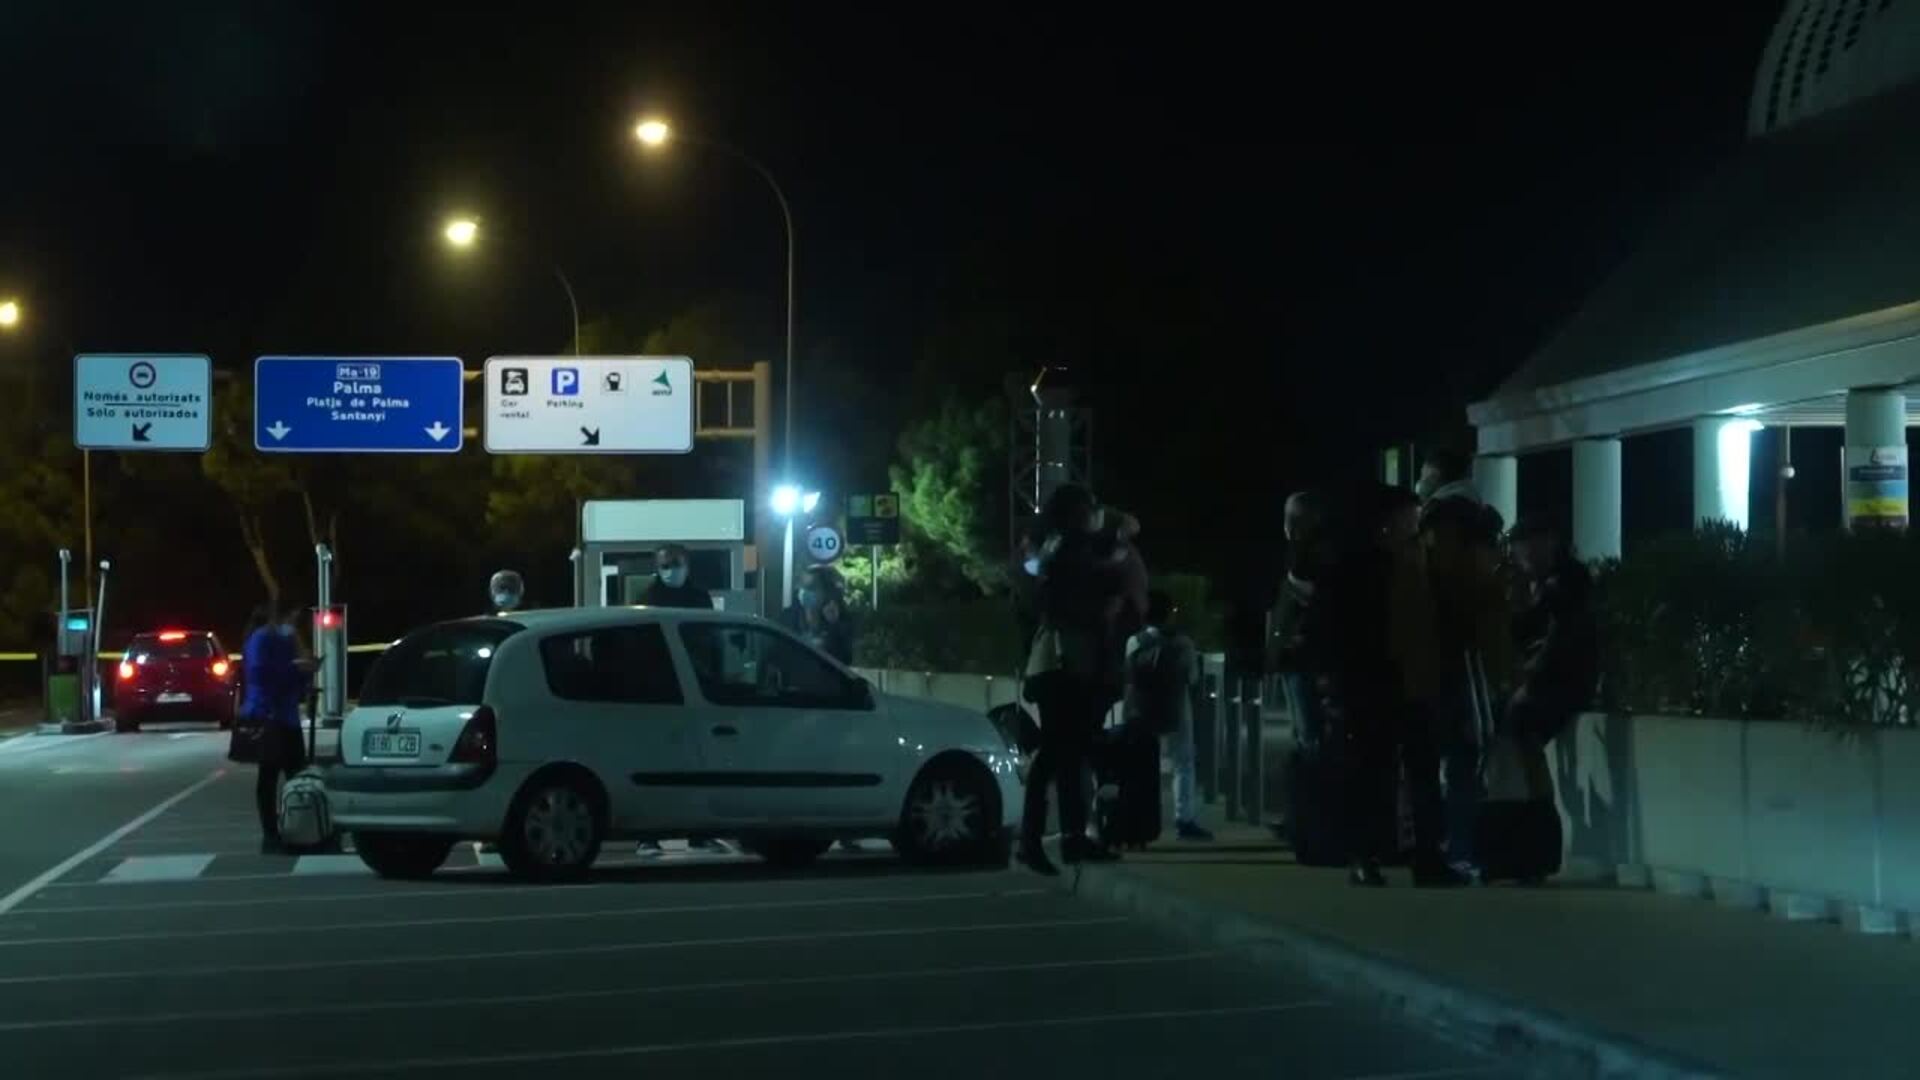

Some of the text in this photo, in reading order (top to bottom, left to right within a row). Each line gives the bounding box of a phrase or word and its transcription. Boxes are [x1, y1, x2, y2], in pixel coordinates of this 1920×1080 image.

[339, 367, 378, 378] Ma-19
[333, 381, 382, 394] Palma
[557, 370, 575, 394] P
[136, 392, 201, 403] autorizats
[350, 396, 366, 408] de
[372, 397, 410, 409] Palma
[500, 400, 518, 408] Car
[546, 400, 584, 409] Parking
[124, 408, 198, 419] autorizados
[811, 537, 837, 550] 40
